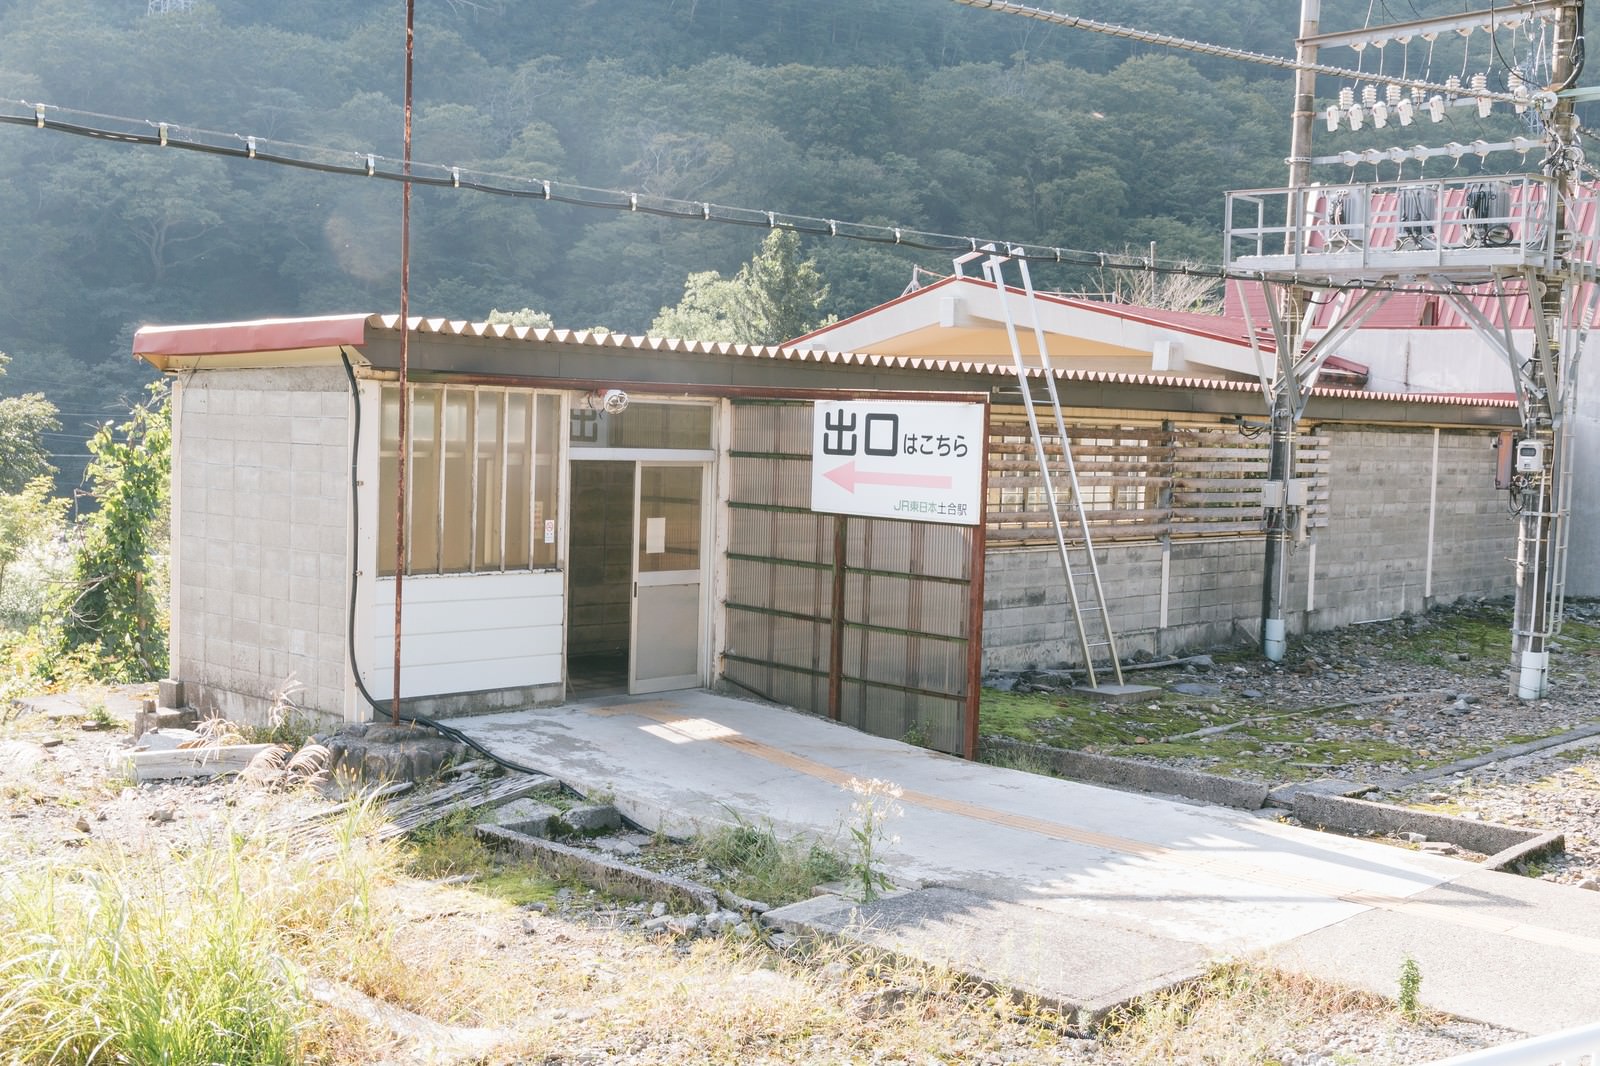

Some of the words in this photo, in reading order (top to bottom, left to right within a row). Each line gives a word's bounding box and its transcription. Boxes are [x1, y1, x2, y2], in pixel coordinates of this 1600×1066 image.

[823, 408, 968, 458] 出口はこちら
[893, 499, 968, 516] JR東日本土合駅
